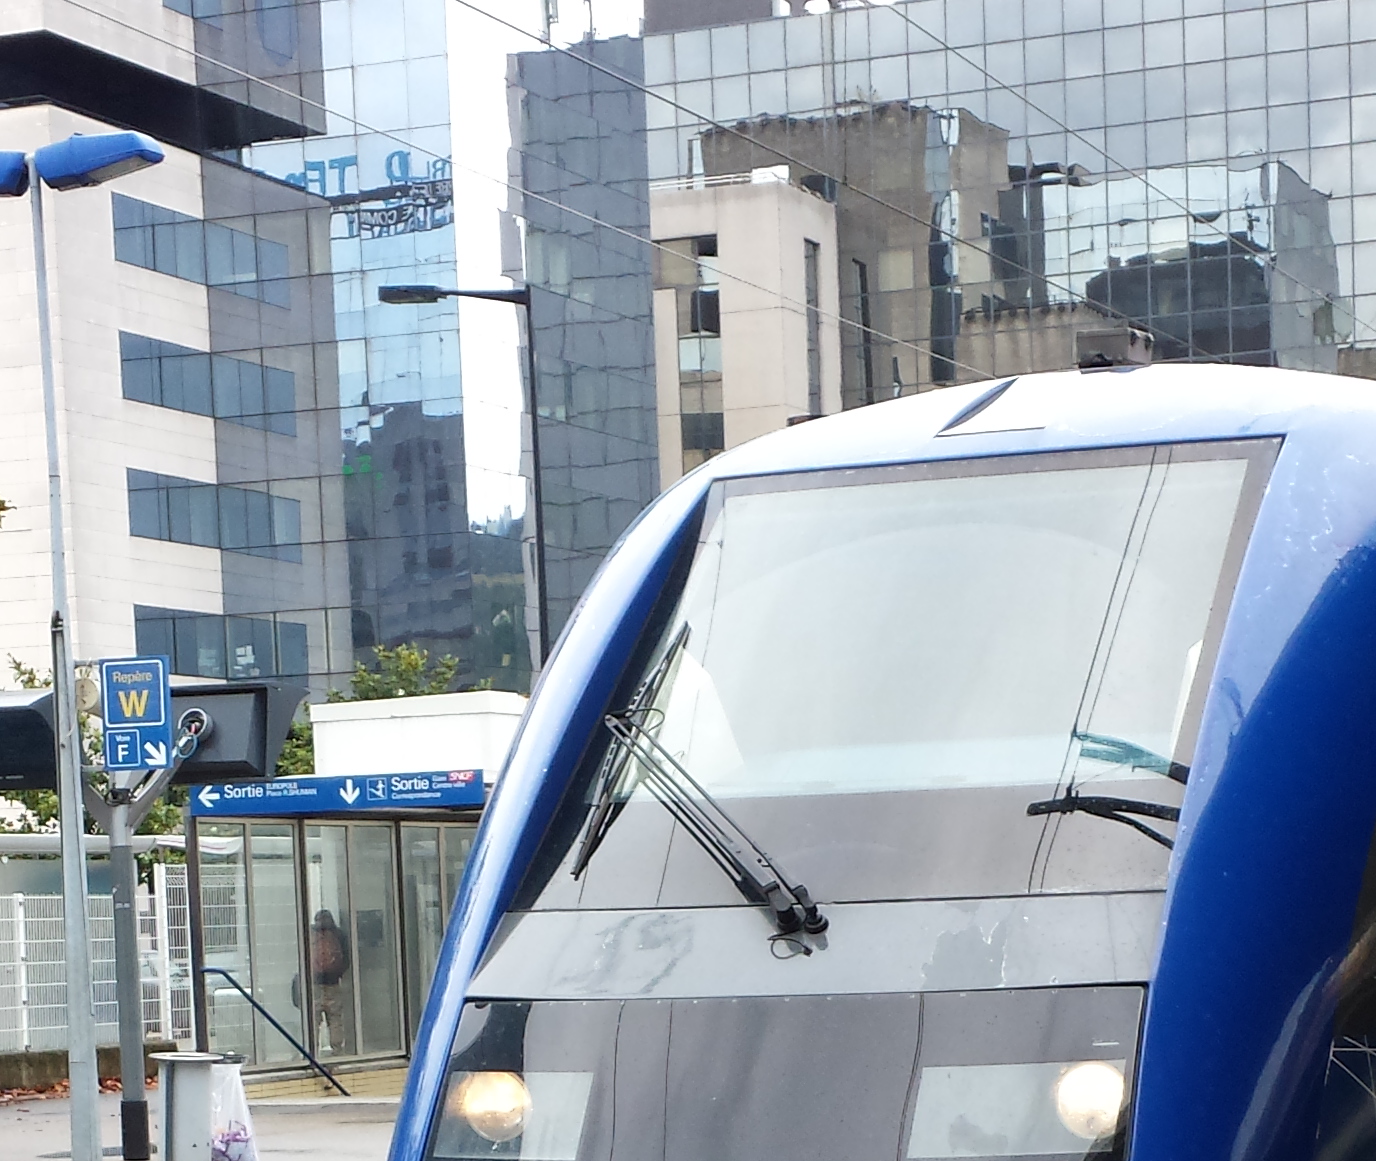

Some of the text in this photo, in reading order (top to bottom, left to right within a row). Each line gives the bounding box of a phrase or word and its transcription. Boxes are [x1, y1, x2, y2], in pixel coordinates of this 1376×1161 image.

[112, 671, 153, 684] Repère
[118, 690, 149, 718] W
[118, 744, 129, 762] F
[391, 775, 429, 791] Sortie
[224, 784, 264, 799] Sortie
